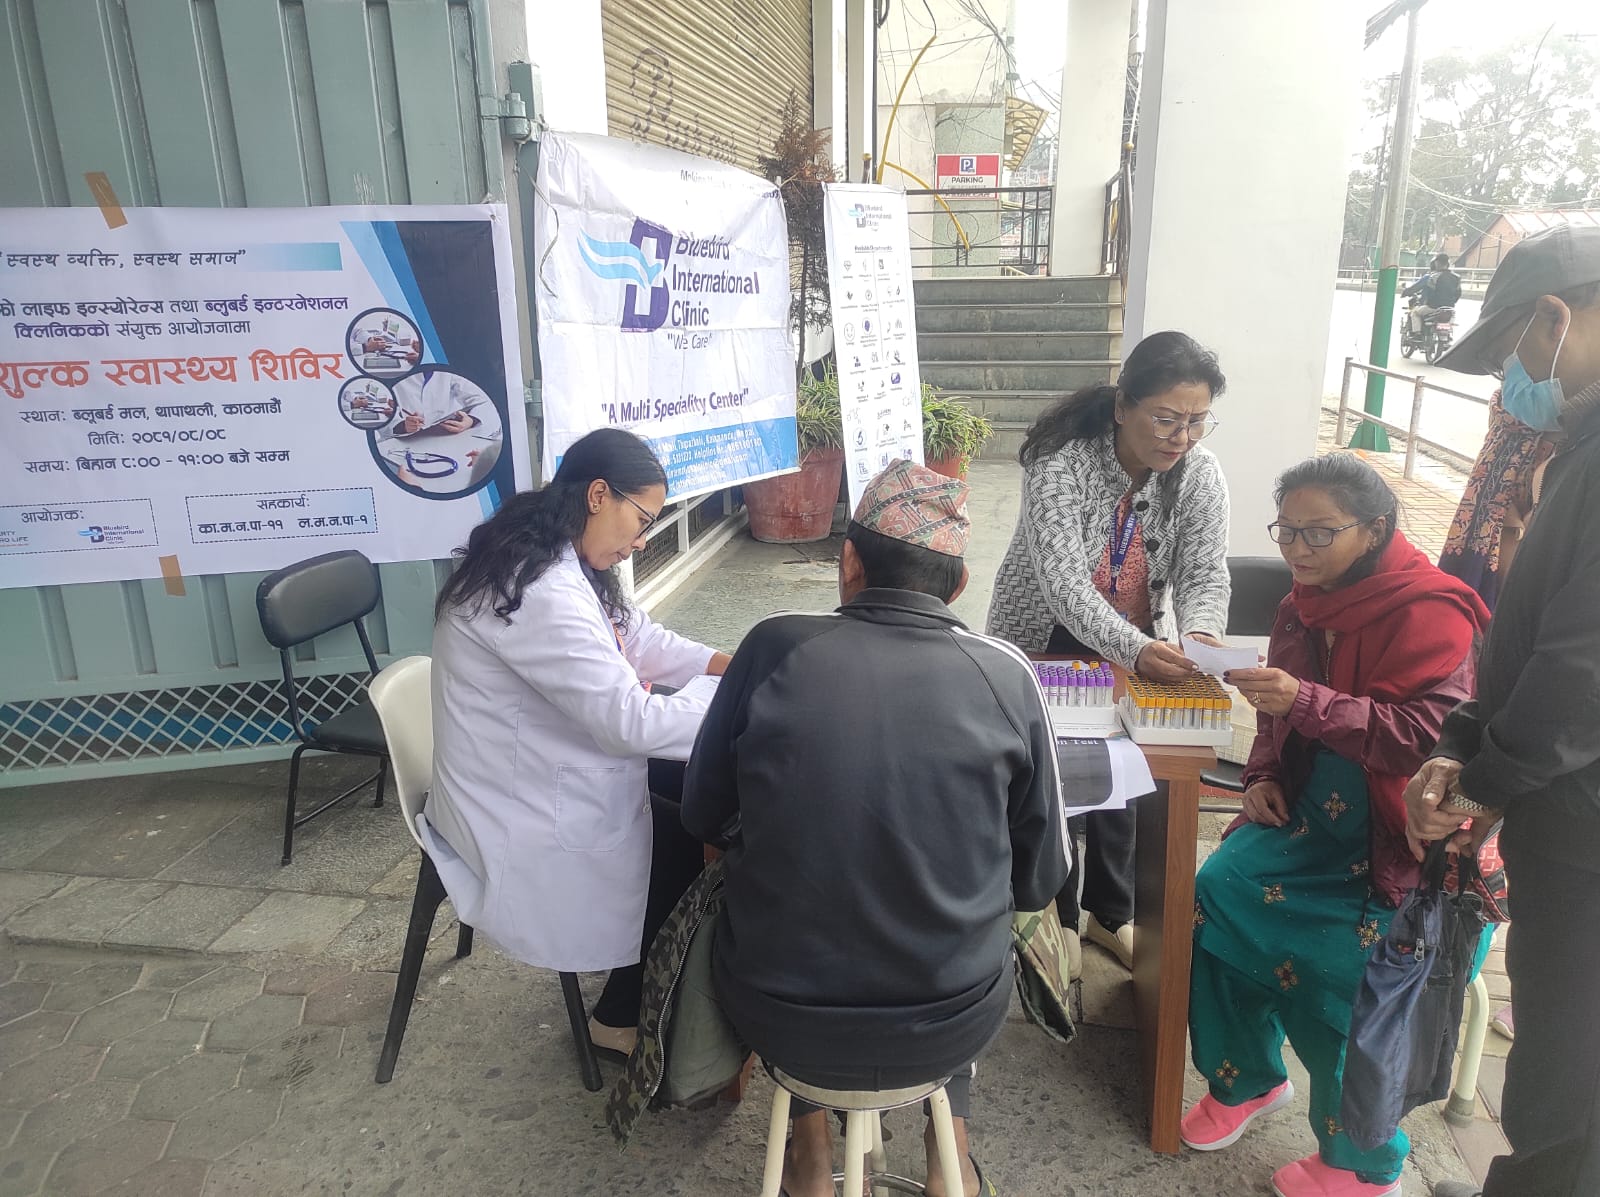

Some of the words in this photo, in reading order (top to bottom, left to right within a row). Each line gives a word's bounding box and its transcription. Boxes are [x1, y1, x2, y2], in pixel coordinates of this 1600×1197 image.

[951, 176, 984, 184] PARKING
[674, 231, 731, 260] Bluebird
[67, 248, 124, 269] व्यक्ति,
[133, 252, 182, 266] स्वस्थ
[672, 264, 760, 295] International
[20, 302, 70, 317] लाइफ
[75, 296, 164, 317] इन्स्योरेन्स
[169, 300, 199, 313] तथा
[203, 294, 249, 316] ब्लुबर्ड
[252, 294, 348, 313] इन्टरनेशनल
[671, 300, 710, 327] Clinic
[14, 320, 110, 339] क्लिनिकको
[115, 319, 162, 340] संयुक्त
[168, 317, 251, 336] आयोजनामा
[248, 347, 345, 382] शिविर
[72, 403, 114, 424] ब्लूबर्ड
[154, 401, 217, 418] थापाथली,
[620, 398, 651, 422] Multi
[653, 393, 707, 422] Speciality
[131, 429, 226, 444] २०८१/०८/०८
[75, 456, 117, 471] बिहान
[121, 456, 161, 469] ८:००
[177, 453, 224, 467] ११:००
[228, 447, 251, 464] बजे
[254, 450, 290, 463] सम्म
